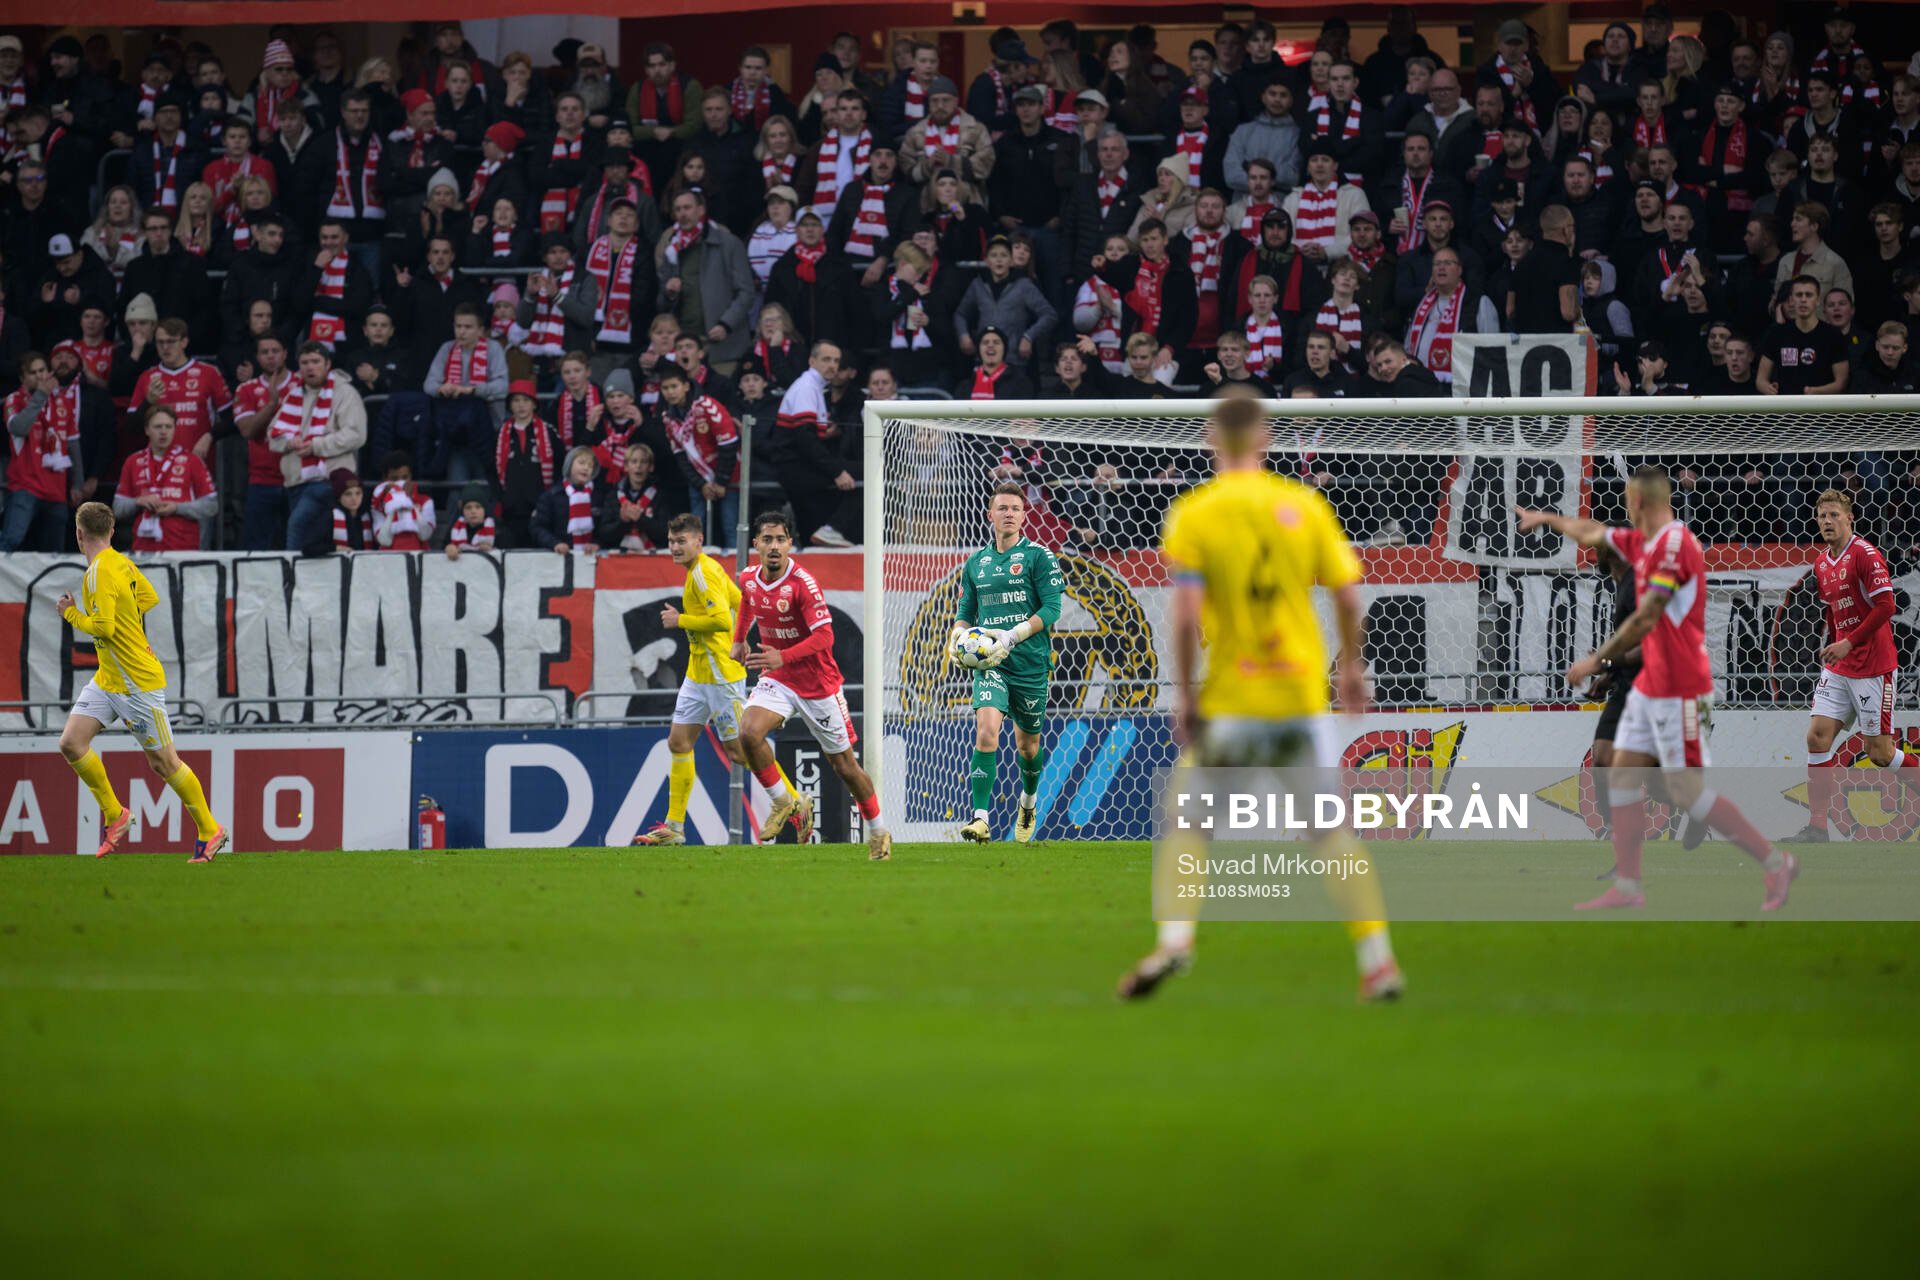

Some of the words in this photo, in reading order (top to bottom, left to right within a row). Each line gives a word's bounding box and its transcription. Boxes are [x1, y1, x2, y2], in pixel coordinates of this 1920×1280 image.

[1466, 344, 1572, 448] AC
[1458, 455, 1565, 558] AB
[983, 612, 1029, 626] ALEMTEK
[979, 690, 992, 702] 30
